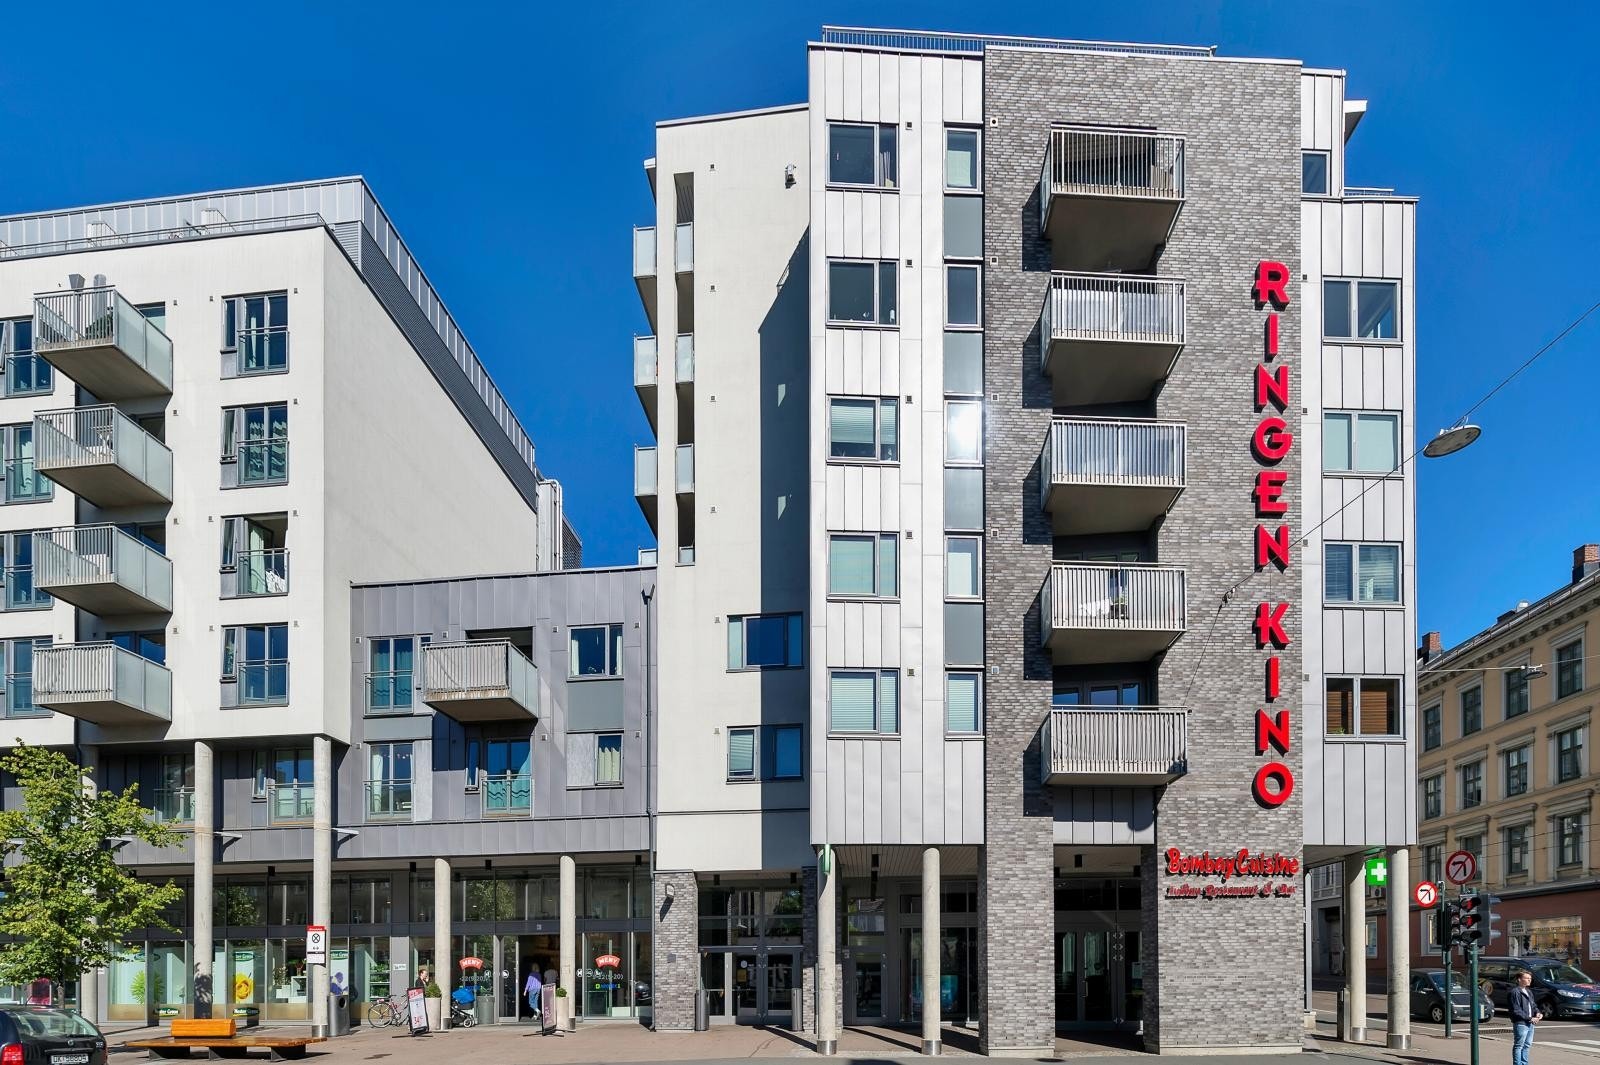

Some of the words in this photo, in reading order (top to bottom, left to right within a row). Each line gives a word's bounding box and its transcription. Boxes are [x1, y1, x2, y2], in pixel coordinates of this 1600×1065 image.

[1252, 260, 1292, 569] RINGEN
[1252, 601, 1294, 806] KINO
[1166, 847, 1236, 880] Bombay
[1237, 848, 1300, 874] Cuisine
